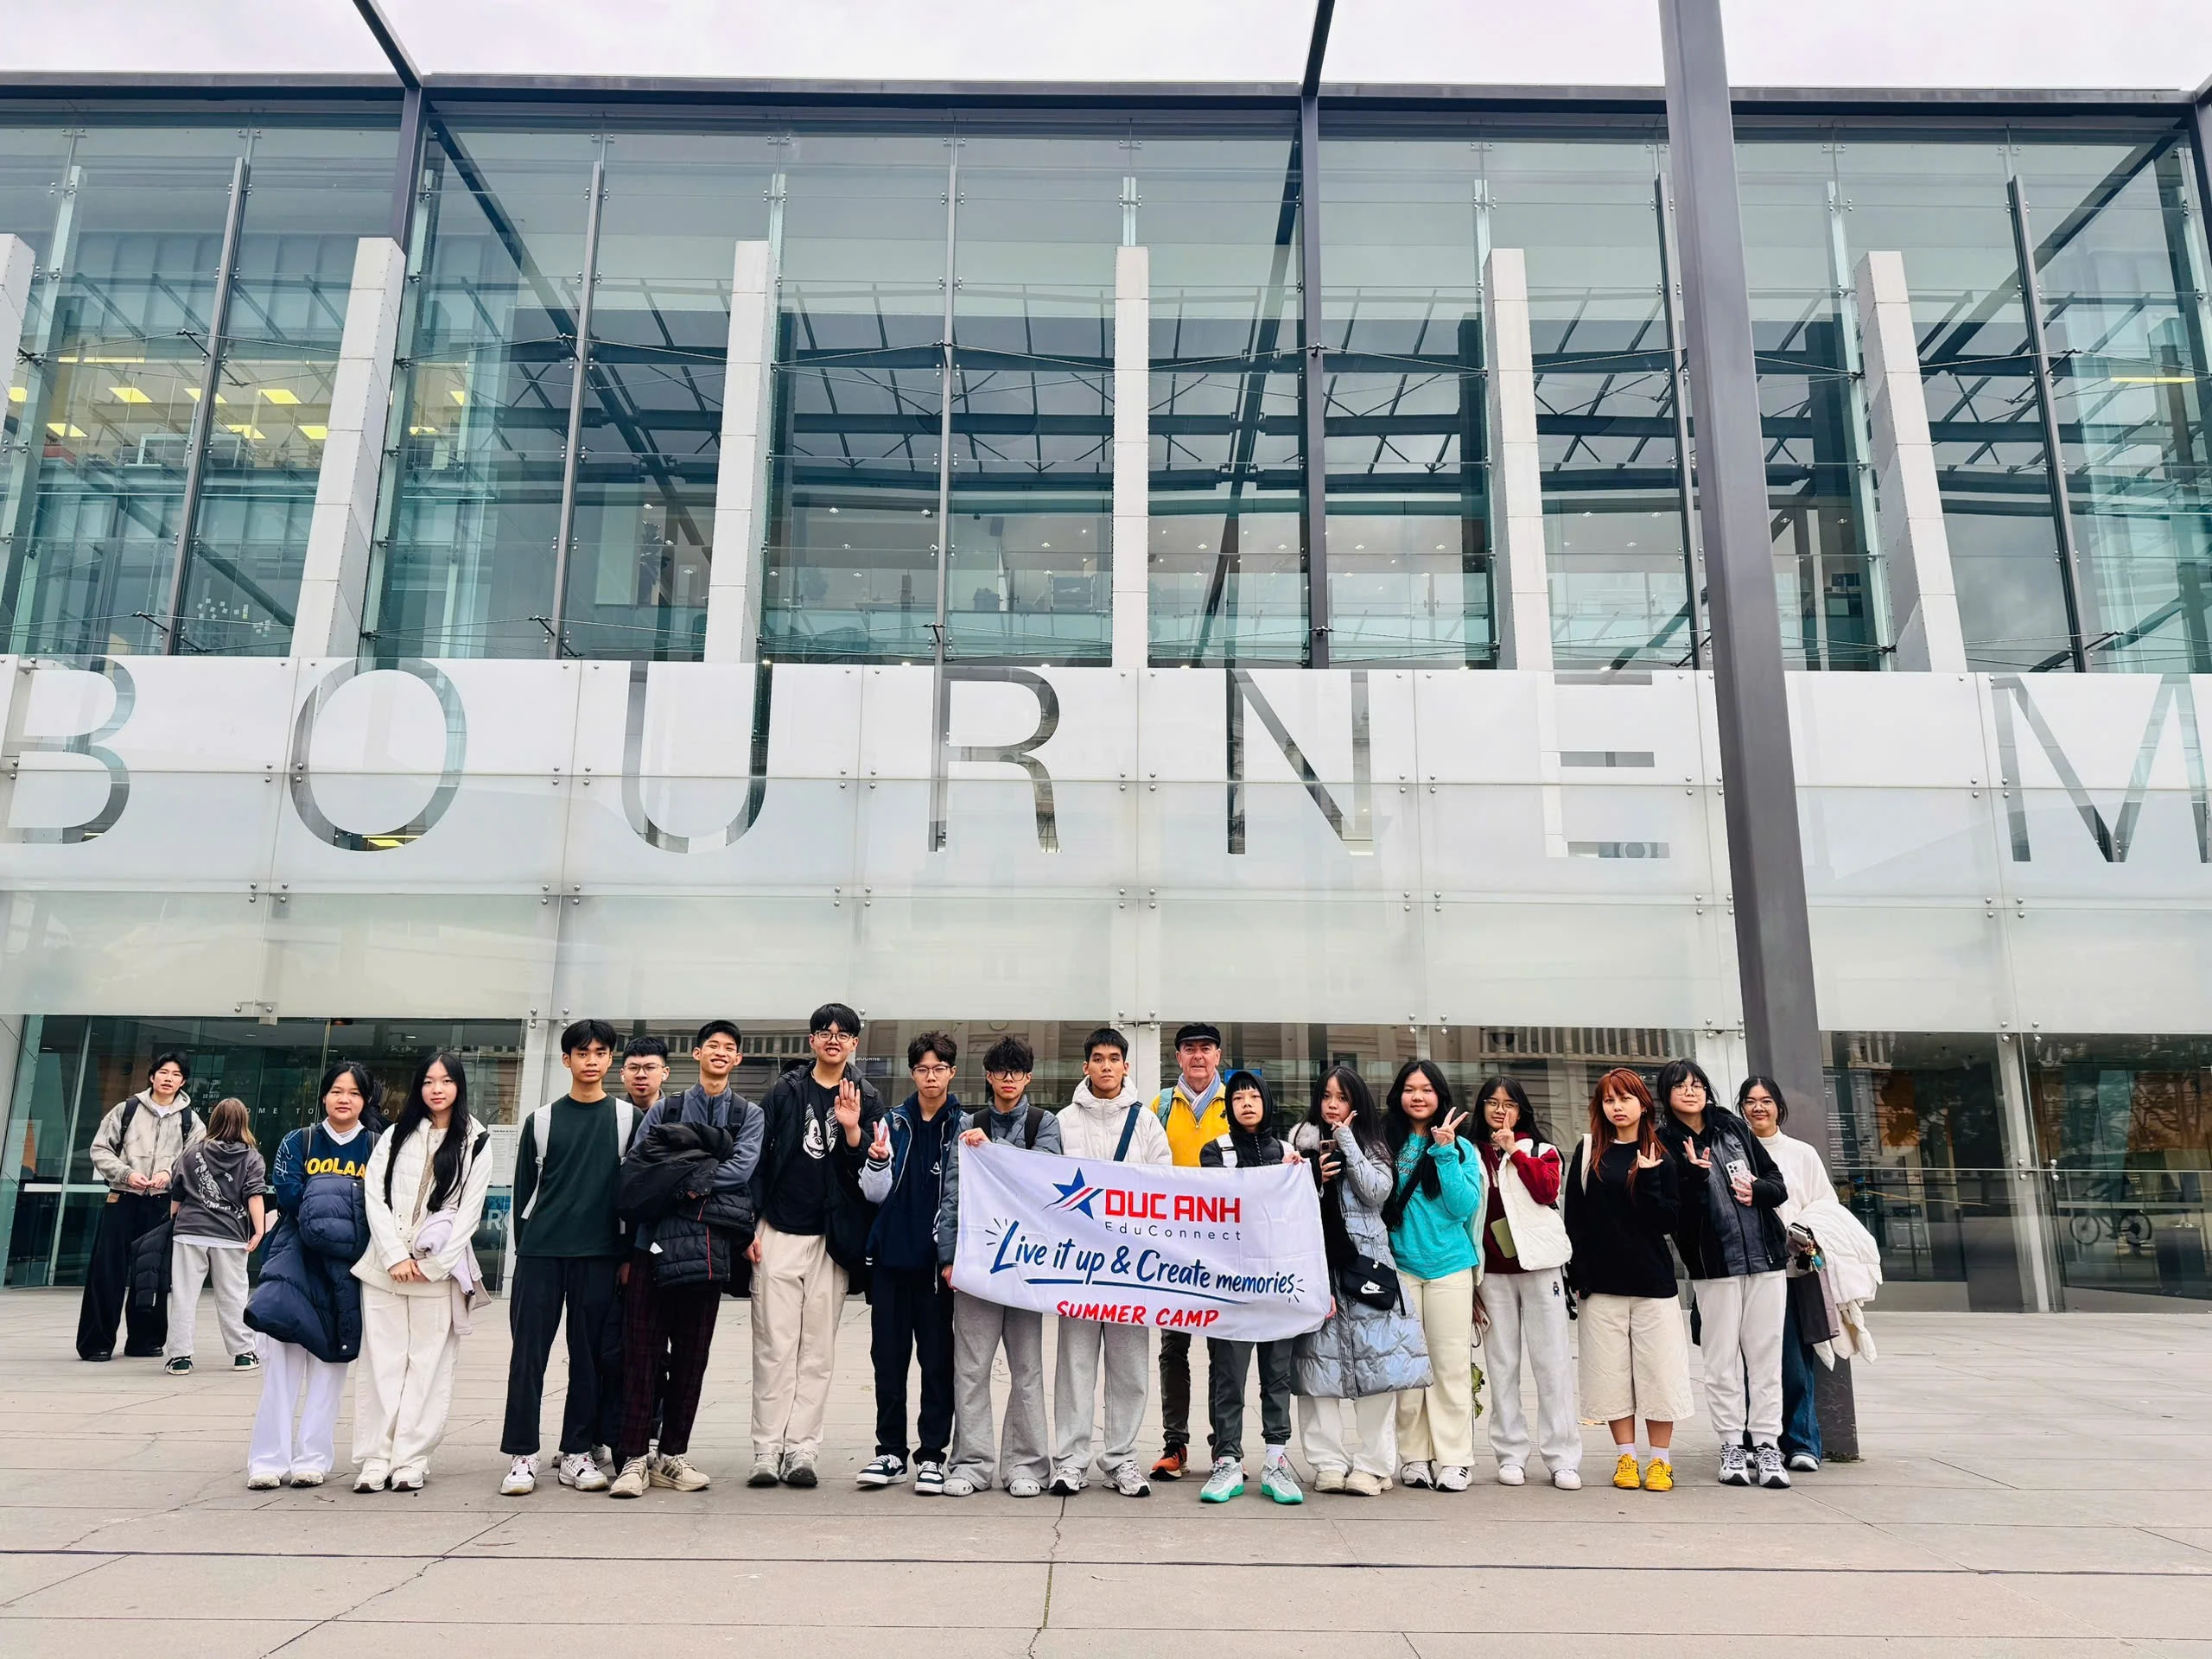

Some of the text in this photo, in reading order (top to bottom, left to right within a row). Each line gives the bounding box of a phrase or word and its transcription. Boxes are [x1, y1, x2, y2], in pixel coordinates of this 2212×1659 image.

[1990, 672, 2212, 864] M
[307, 1157, 366, 1179] OOLAA
[1105, 1189, 1241, 1224] DUC ANH
[1105, 1221, 1241, 1241] EduConnect
[990, 1219, 1295, 1294] Live it up & Create memories
[1056, 1300, 1219, 1327] SUMMER CAMP
